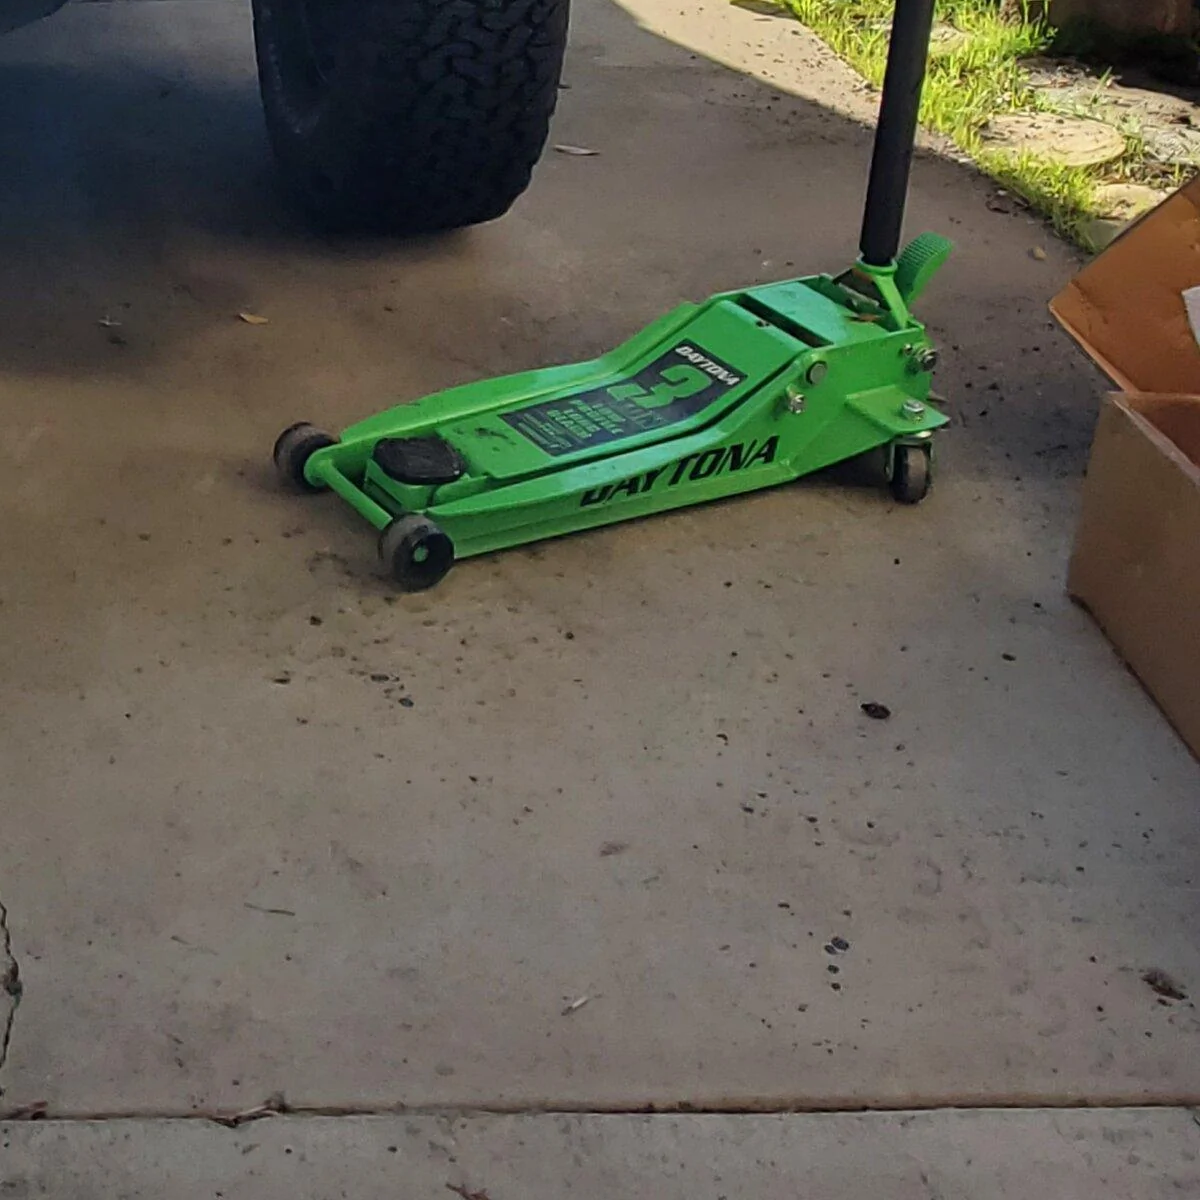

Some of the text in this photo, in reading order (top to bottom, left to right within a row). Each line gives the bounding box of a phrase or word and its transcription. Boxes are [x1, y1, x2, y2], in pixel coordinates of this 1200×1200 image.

[607, 364, 713, 410] 3
[673, 344, 741, 387] DAYTONA
[580, 435, 780, 506] DAYTONA
